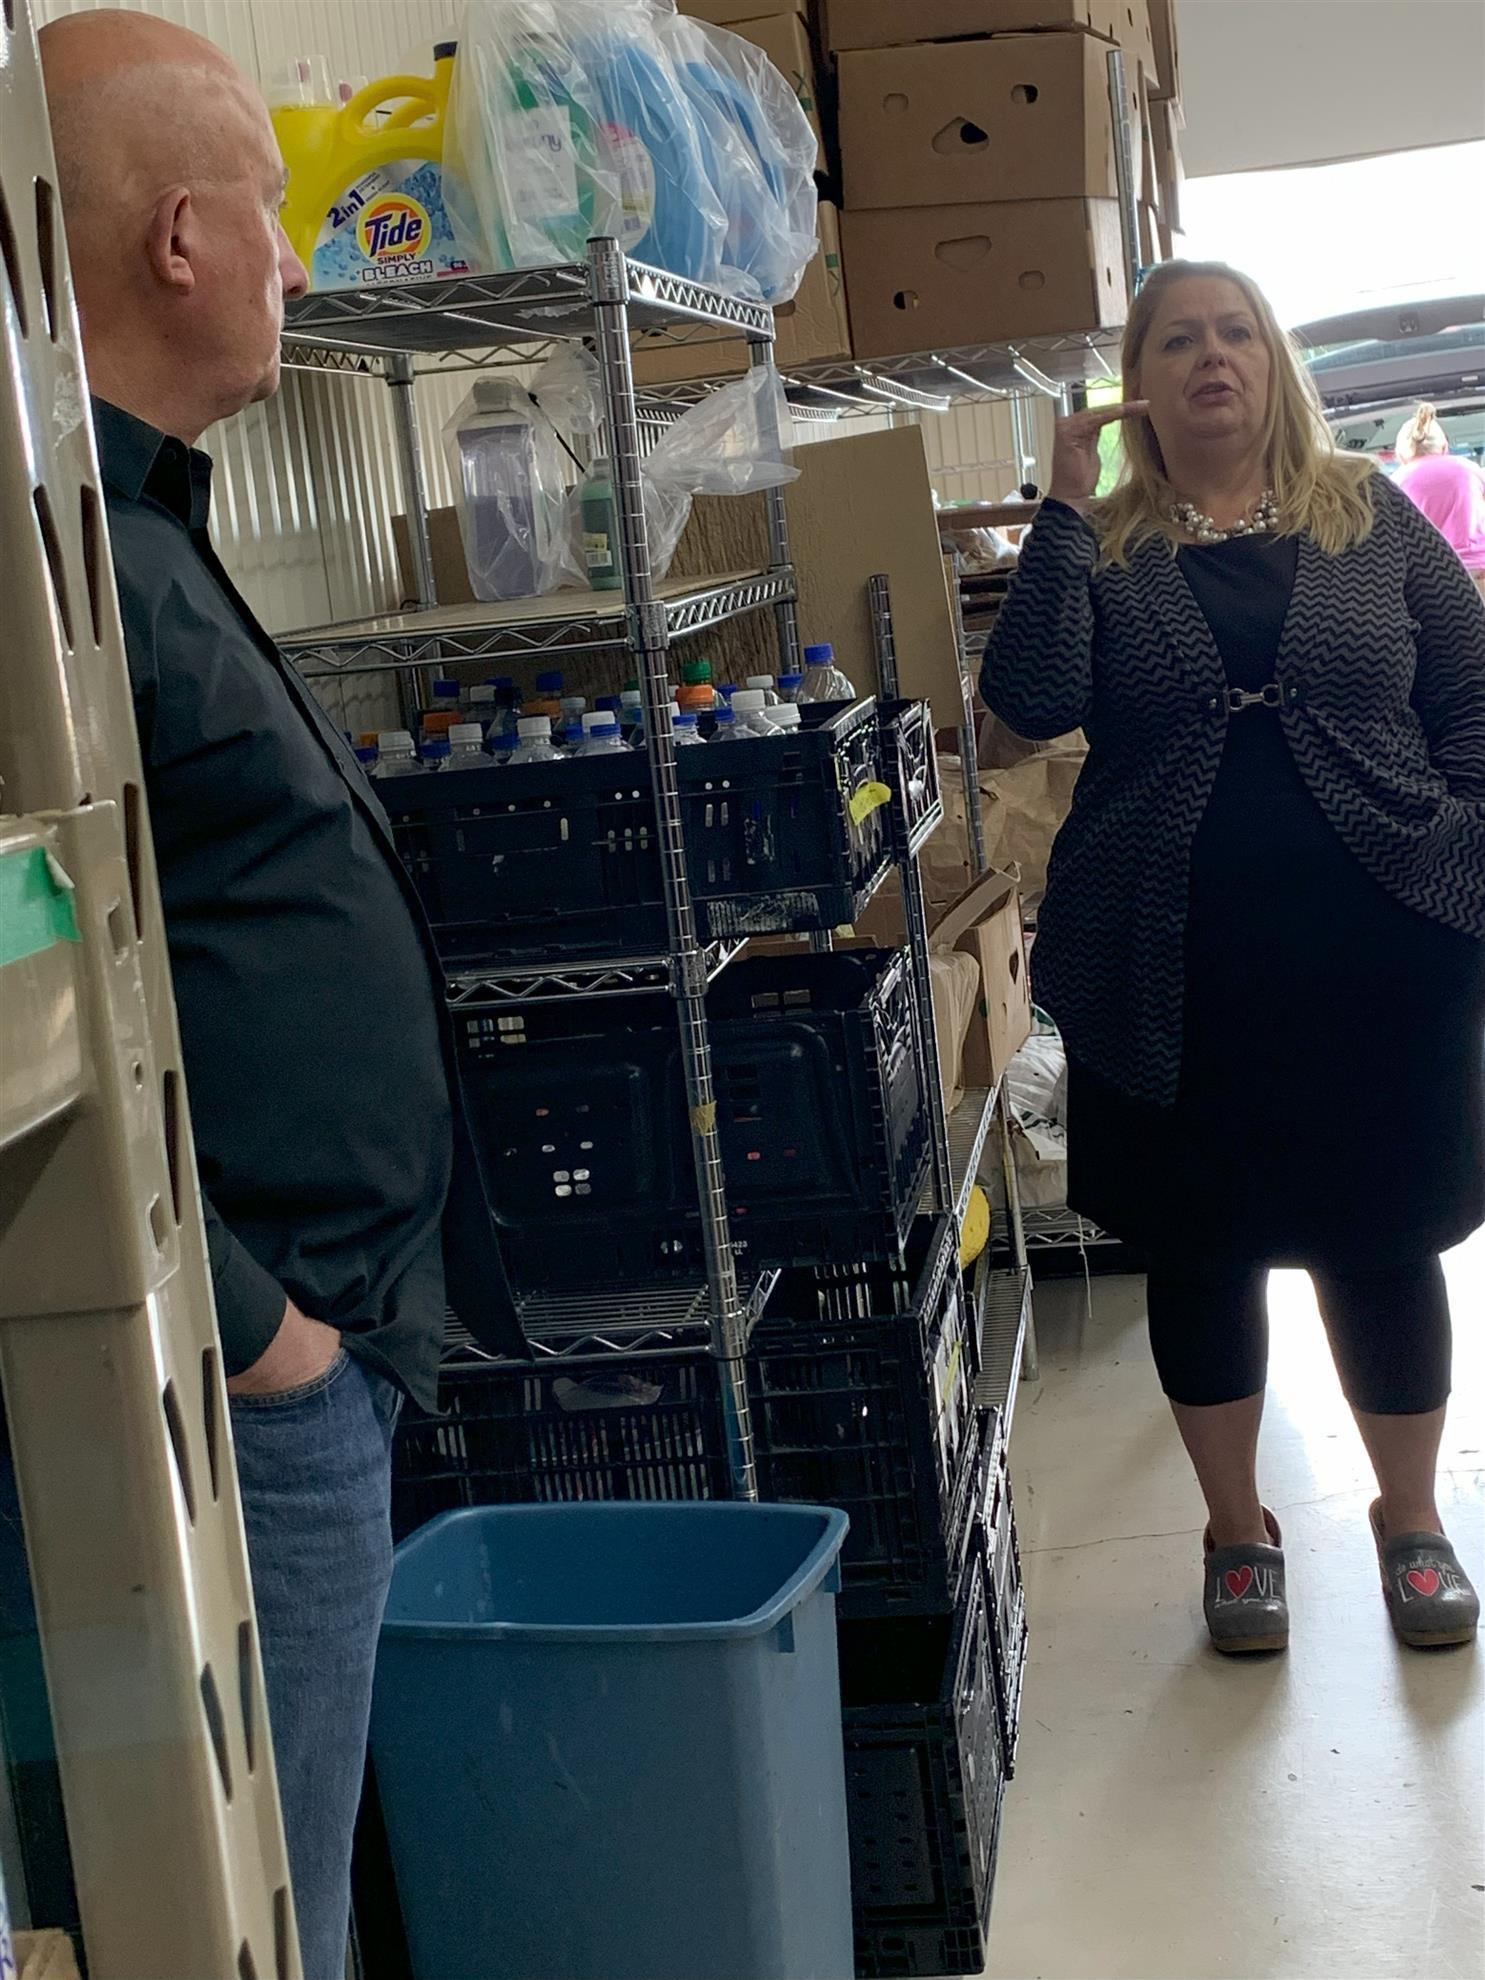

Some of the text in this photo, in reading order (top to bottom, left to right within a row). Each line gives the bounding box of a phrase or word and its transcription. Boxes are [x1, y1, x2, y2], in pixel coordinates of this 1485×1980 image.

[365, 211, 423, 257] Tide
[377, 252, 416, 265] SIMPLY
[362, 259, 433, 282] BLEACH
